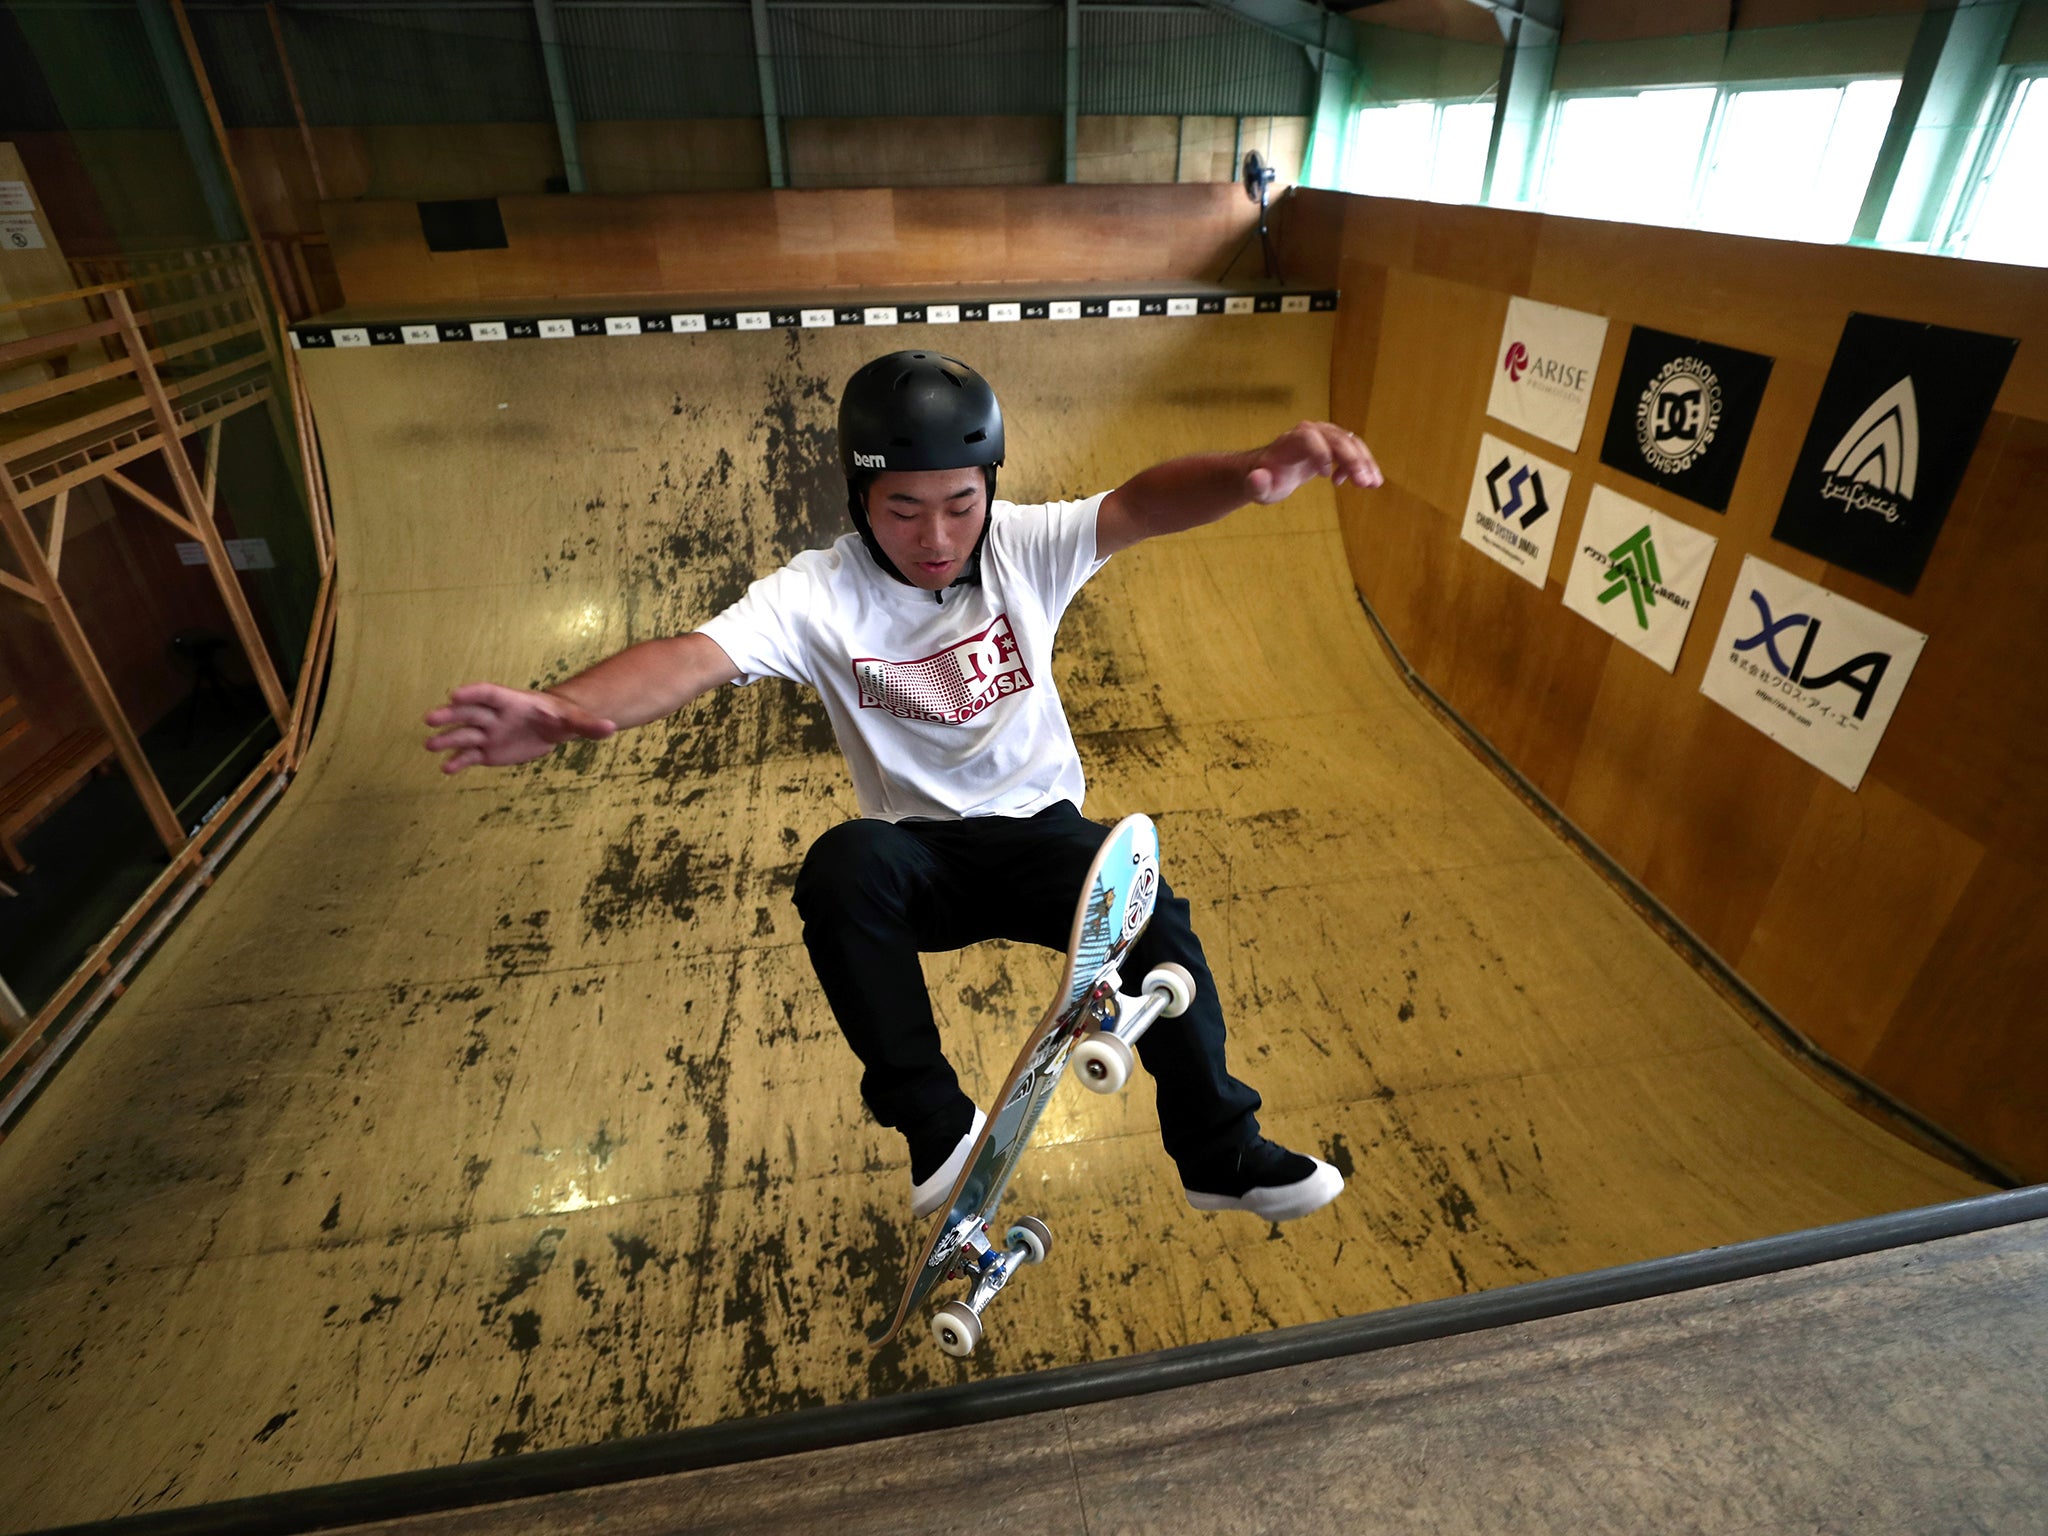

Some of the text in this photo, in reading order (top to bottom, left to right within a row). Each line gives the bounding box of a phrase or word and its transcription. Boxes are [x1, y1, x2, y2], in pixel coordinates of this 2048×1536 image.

[1530, 356, 1588, 392] ARISE
[853, 450, 886, 468] bern
[956, 617, 1023, 689] DC
[1733, 588, 1892, 721] XIA
